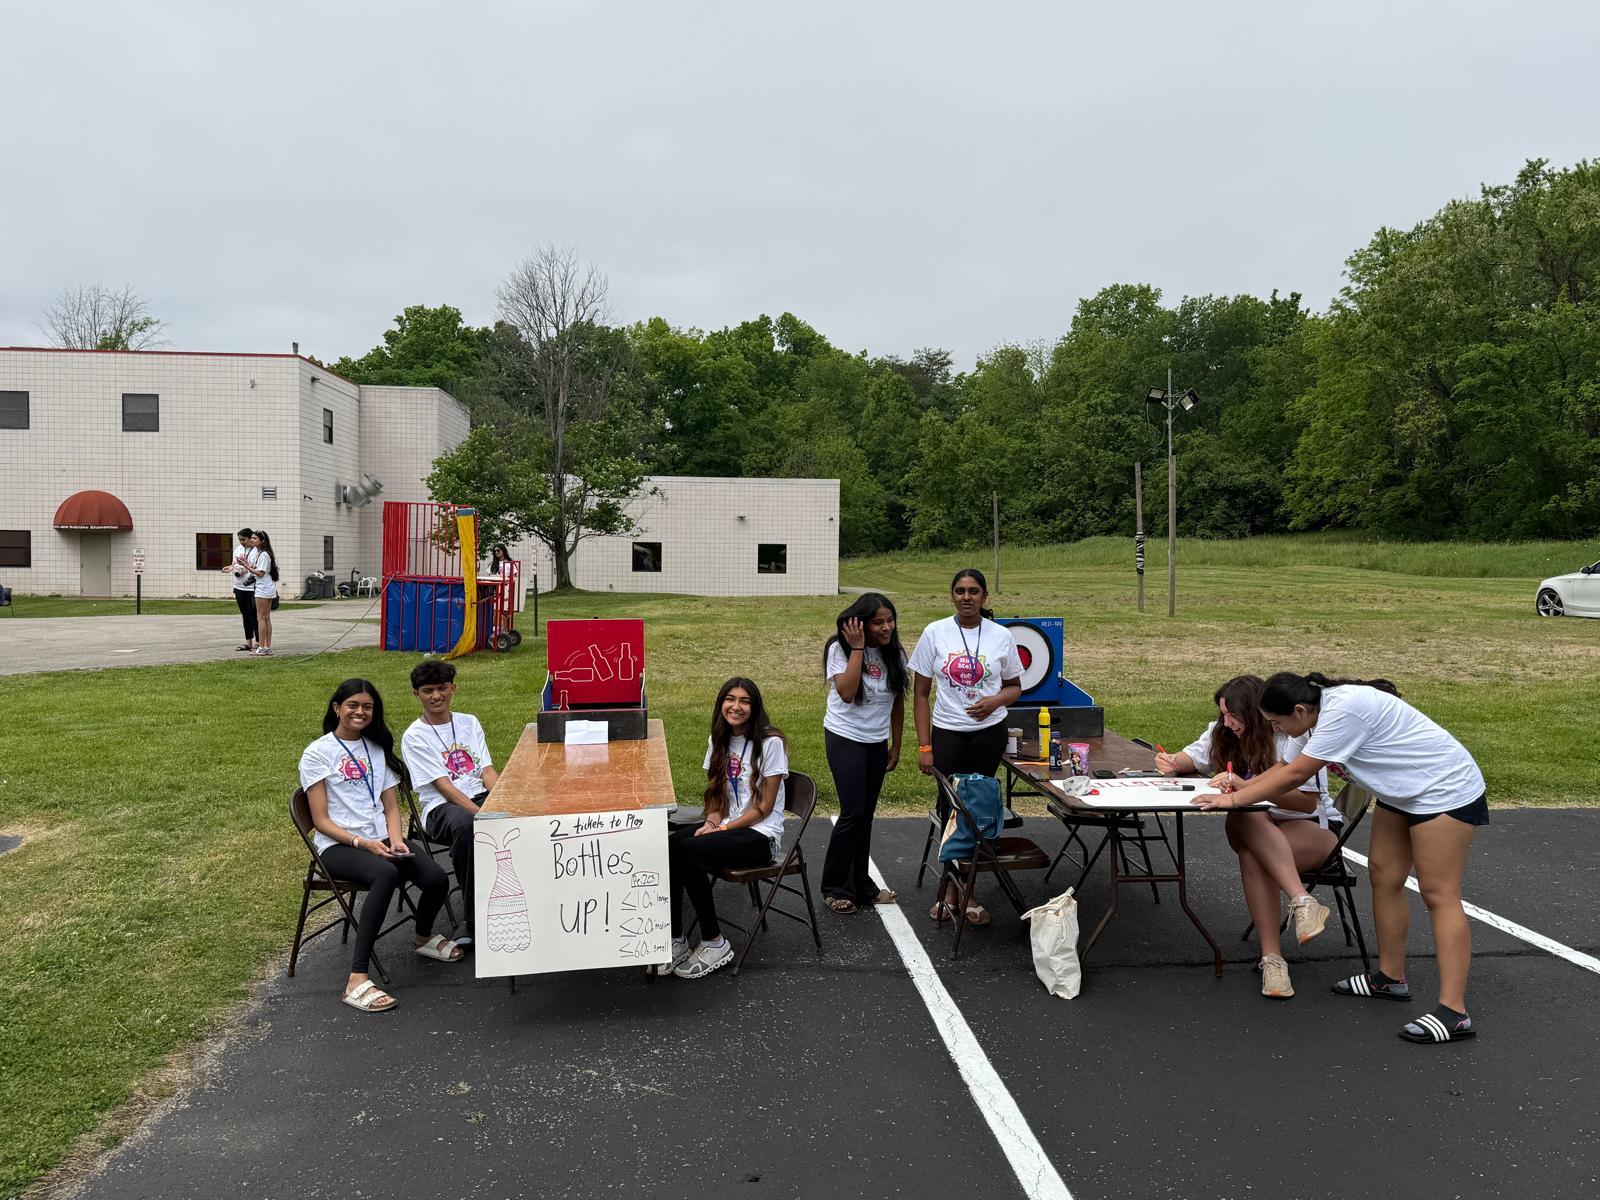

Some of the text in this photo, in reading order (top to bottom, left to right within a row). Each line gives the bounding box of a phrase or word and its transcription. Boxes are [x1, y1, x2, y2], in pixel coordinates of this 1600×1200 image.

[549, 819, 569, 838] 2
[573, 814, 605, 834] tickets
[609, 815, 622, 829] to
[553, 838, 634, 880] Bottles
